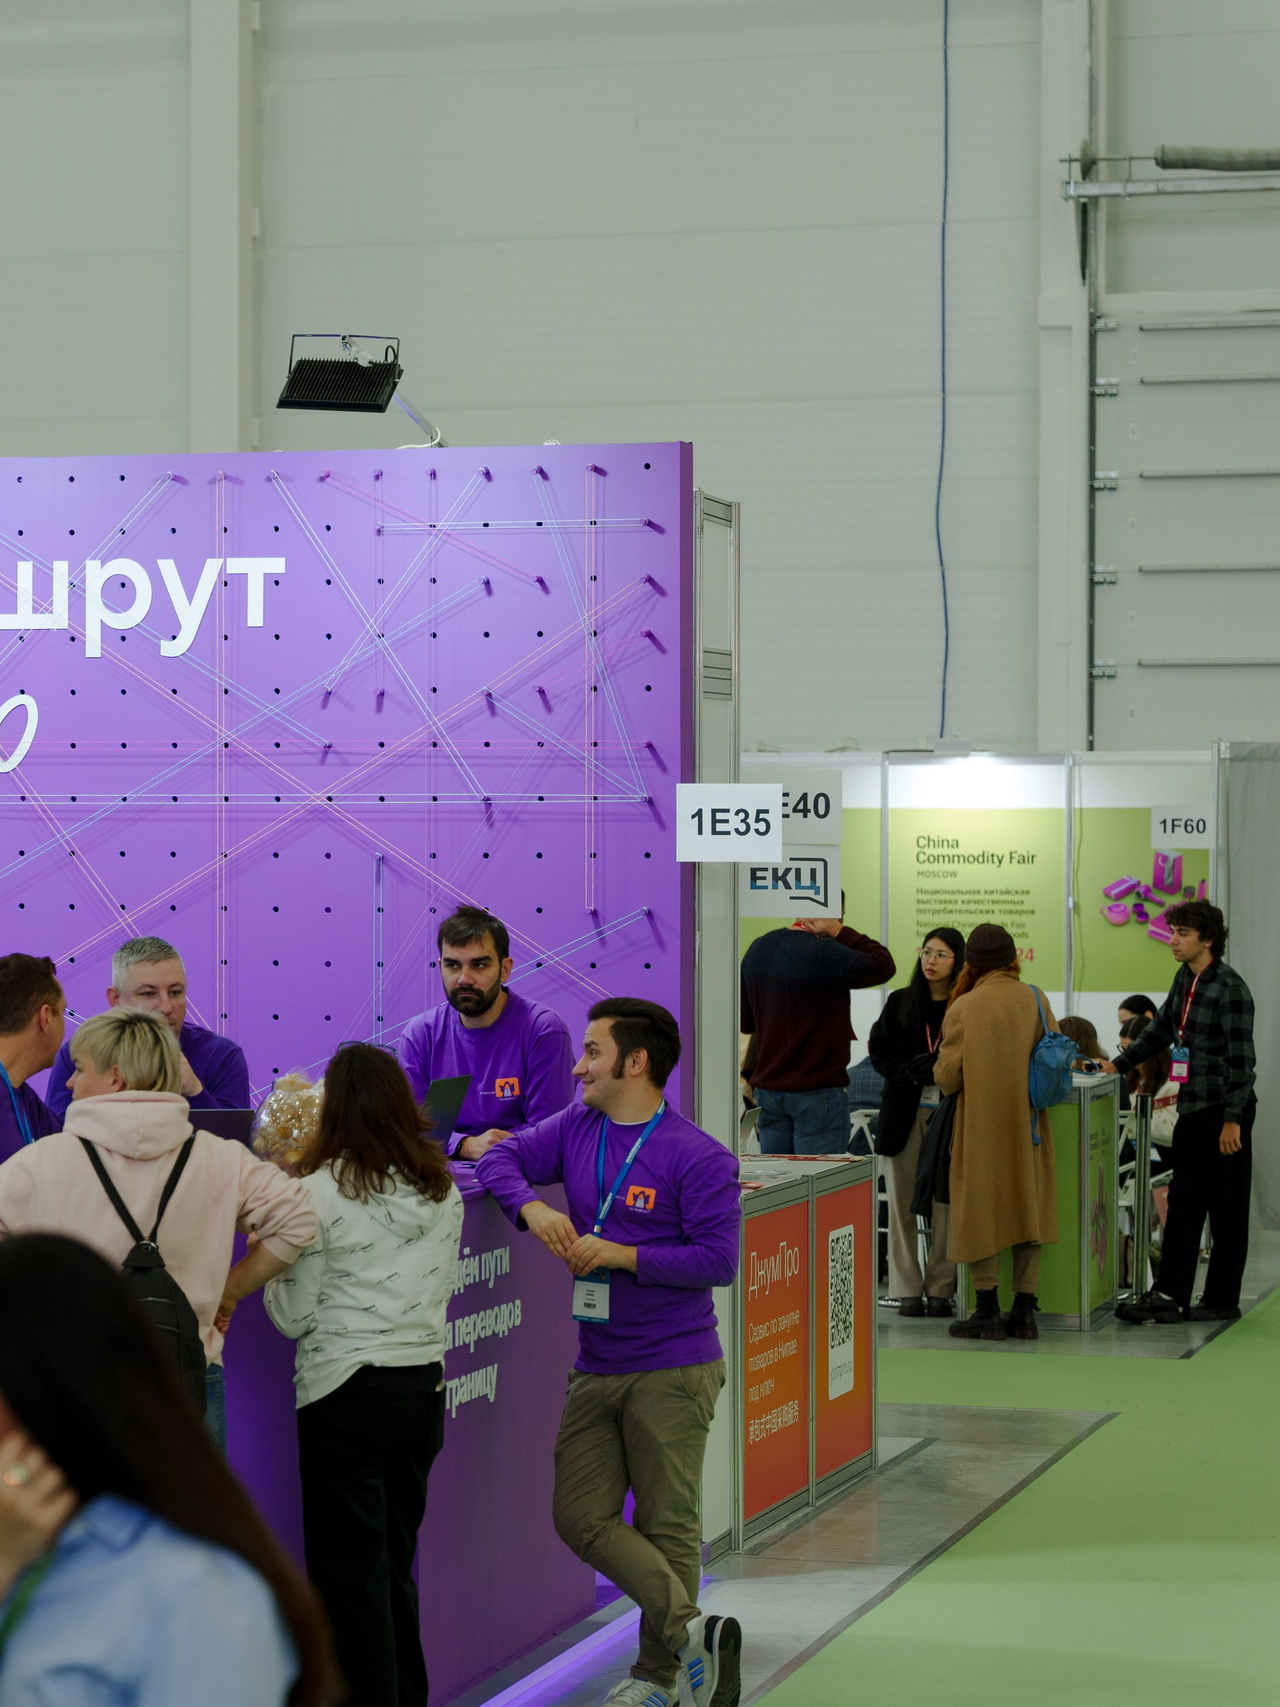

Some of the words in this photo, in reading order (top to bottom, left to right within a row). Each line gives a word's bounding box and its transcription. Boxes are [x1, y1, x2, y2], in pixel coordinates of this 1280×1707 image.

[691, 808, 771, 836] 1E35
[1159, 818, 1207, 834] 1F60
[916, 835, 959, 849] China
[916, 851, 1004, 868] Commodity
[1009, 851, 1037, 865] Fair
[749, 867, 821, 896] ЕКЦ
[916, 870, 958, 879] MOSCOW
[916, 888, 981, 897] Национальная
[916, 906, 995, 917] потребительских
[998, 908, 1036, 917] товаров
[481, 1247, 510, 1289] пути
[748, 1241, 800, 1301] ДжумПро
[455, 1299, 522, 1353] переводов
[748, 1322, 770, 1345] Сервис
[770, 1318, 777, 1336] по
[748, 1350, 773, 1374] товаров
[446, 1363, 498, 1418] границу
[748, 1385, 760, 1404] под
